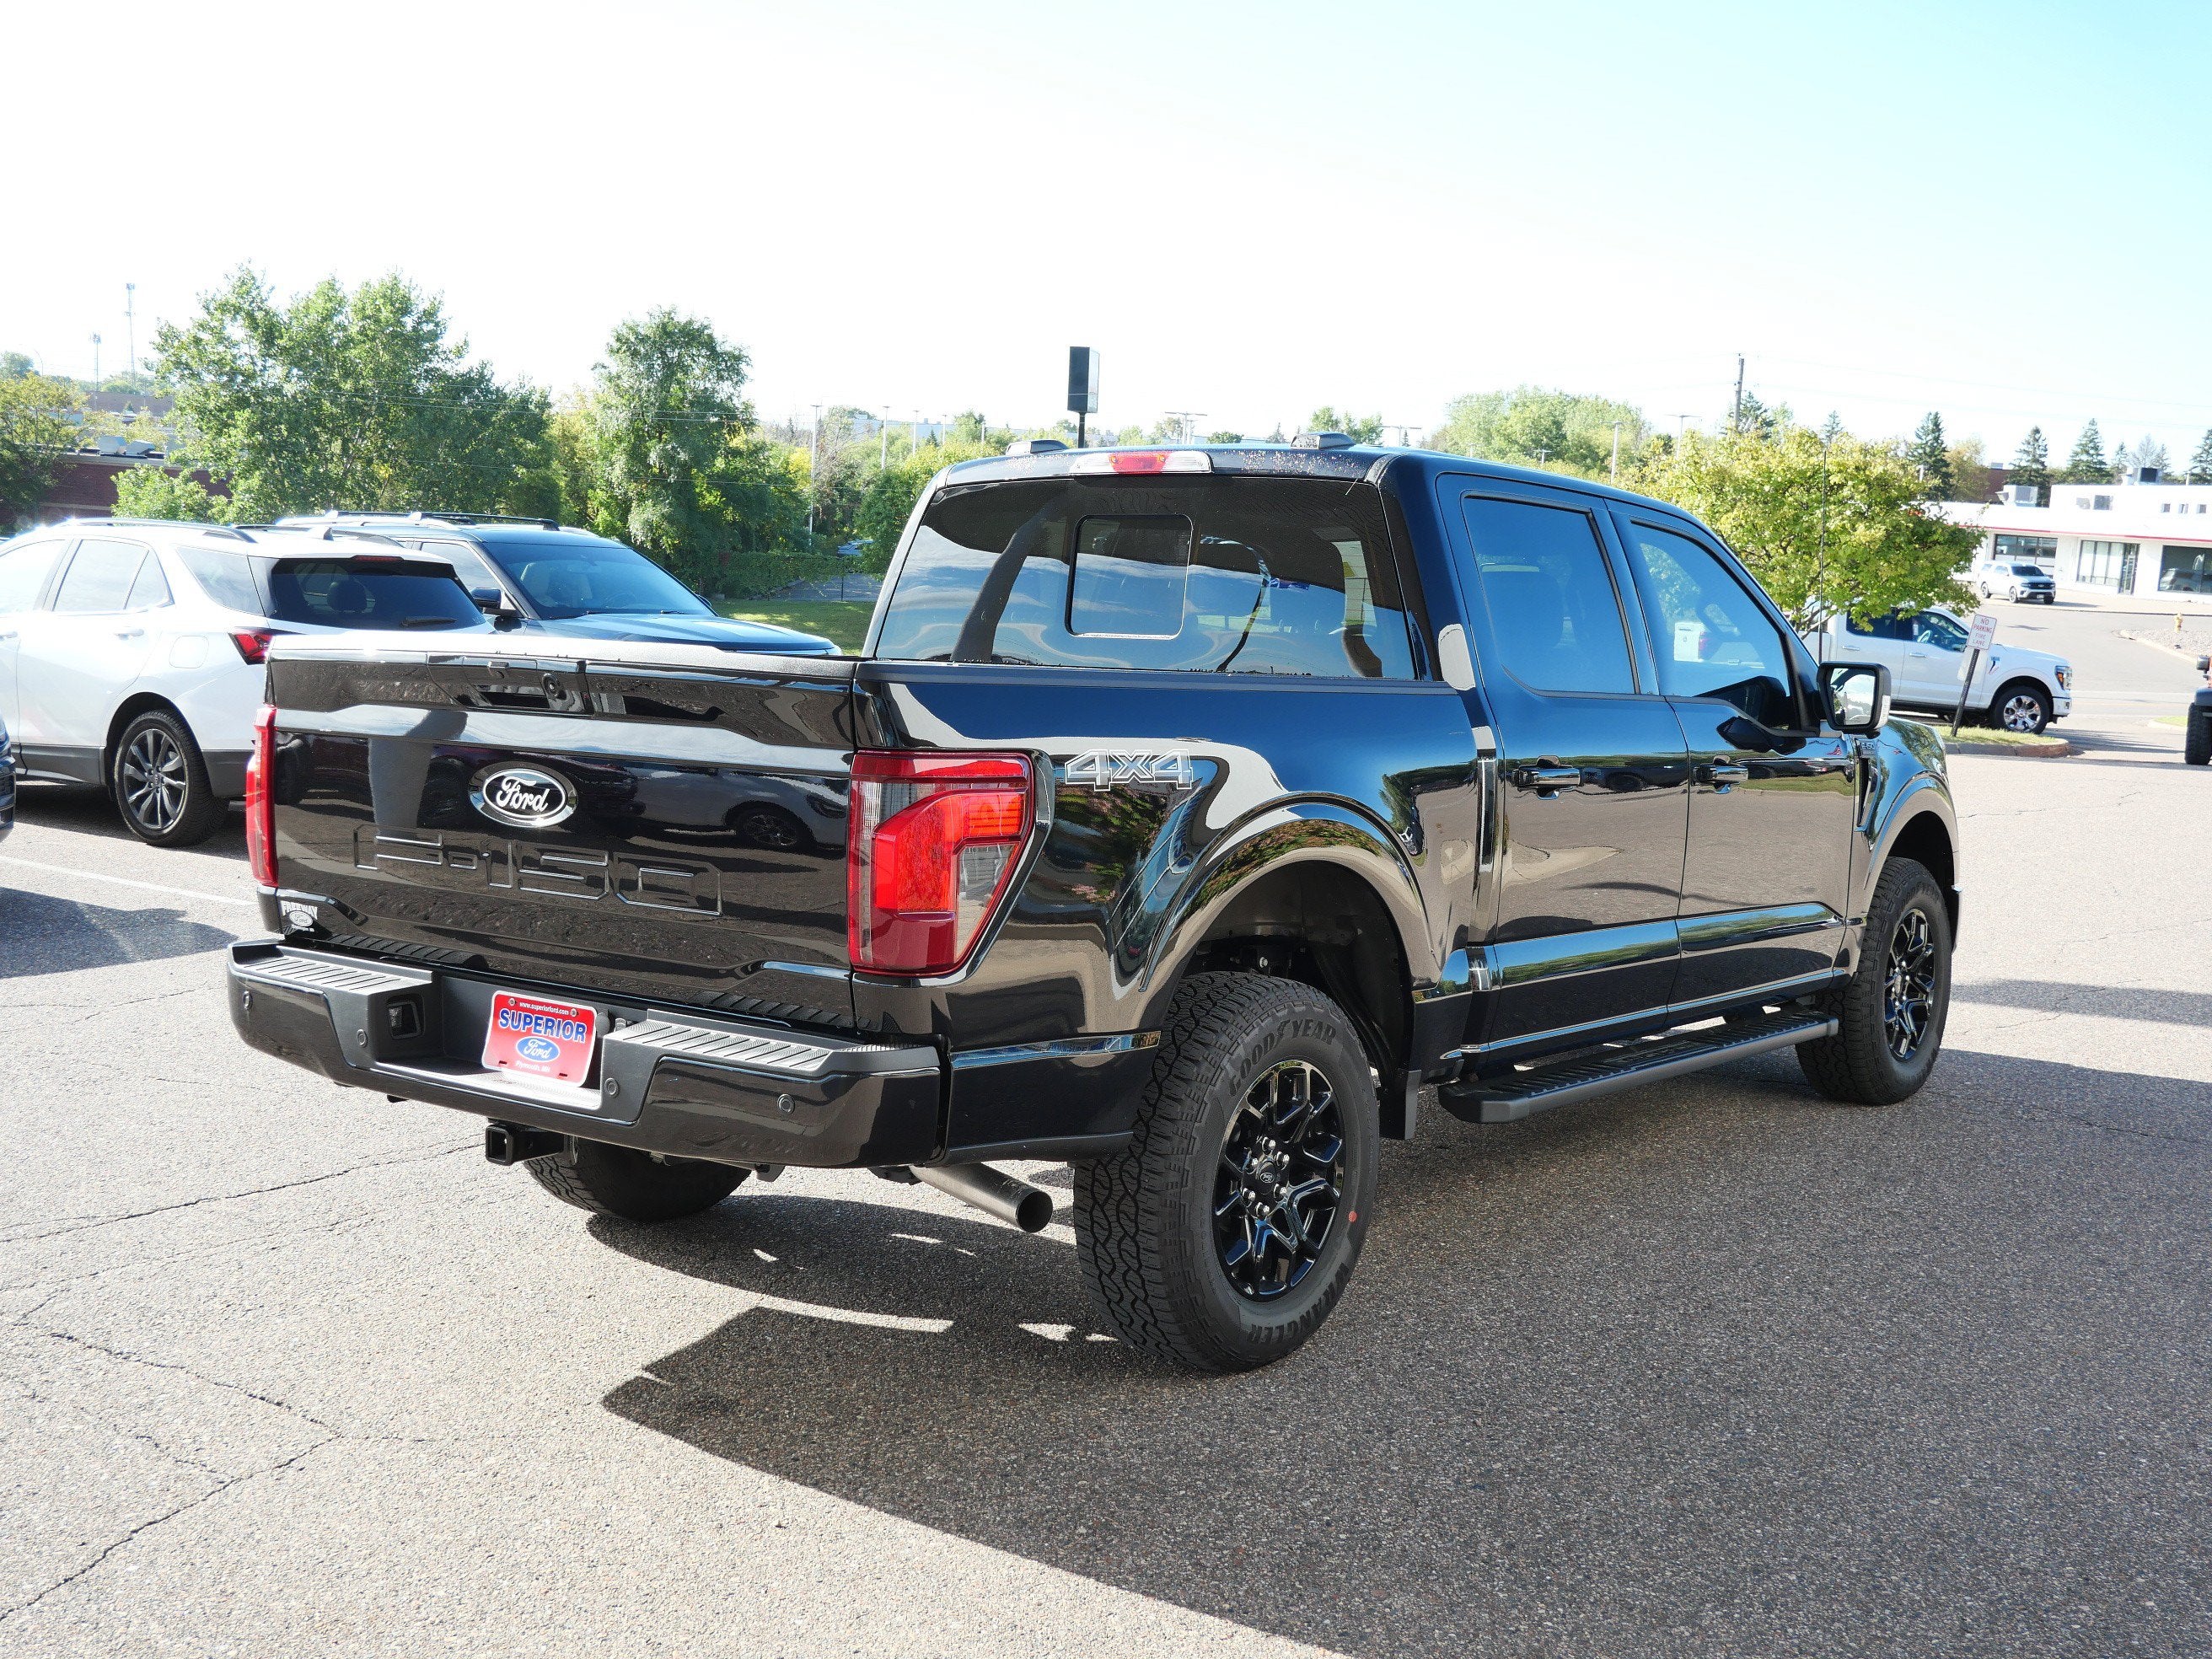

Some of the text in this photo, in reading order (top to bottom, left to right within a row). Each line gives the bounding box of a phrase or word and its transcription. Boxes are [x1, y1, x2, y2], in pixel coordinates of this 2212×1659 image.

[1973, 625, 1993, 633] PARKING
[496, 776, 550, 813] Ford
[352, 823, 722, 916] F-150
[280, 900, 318, 921] FREEWAY
[519, 1002, 569, 1016] www.superiorford.com
[499, 1008, 588, 1044] SUPERIOR
[523, 1039, 552, 1059] Ford
